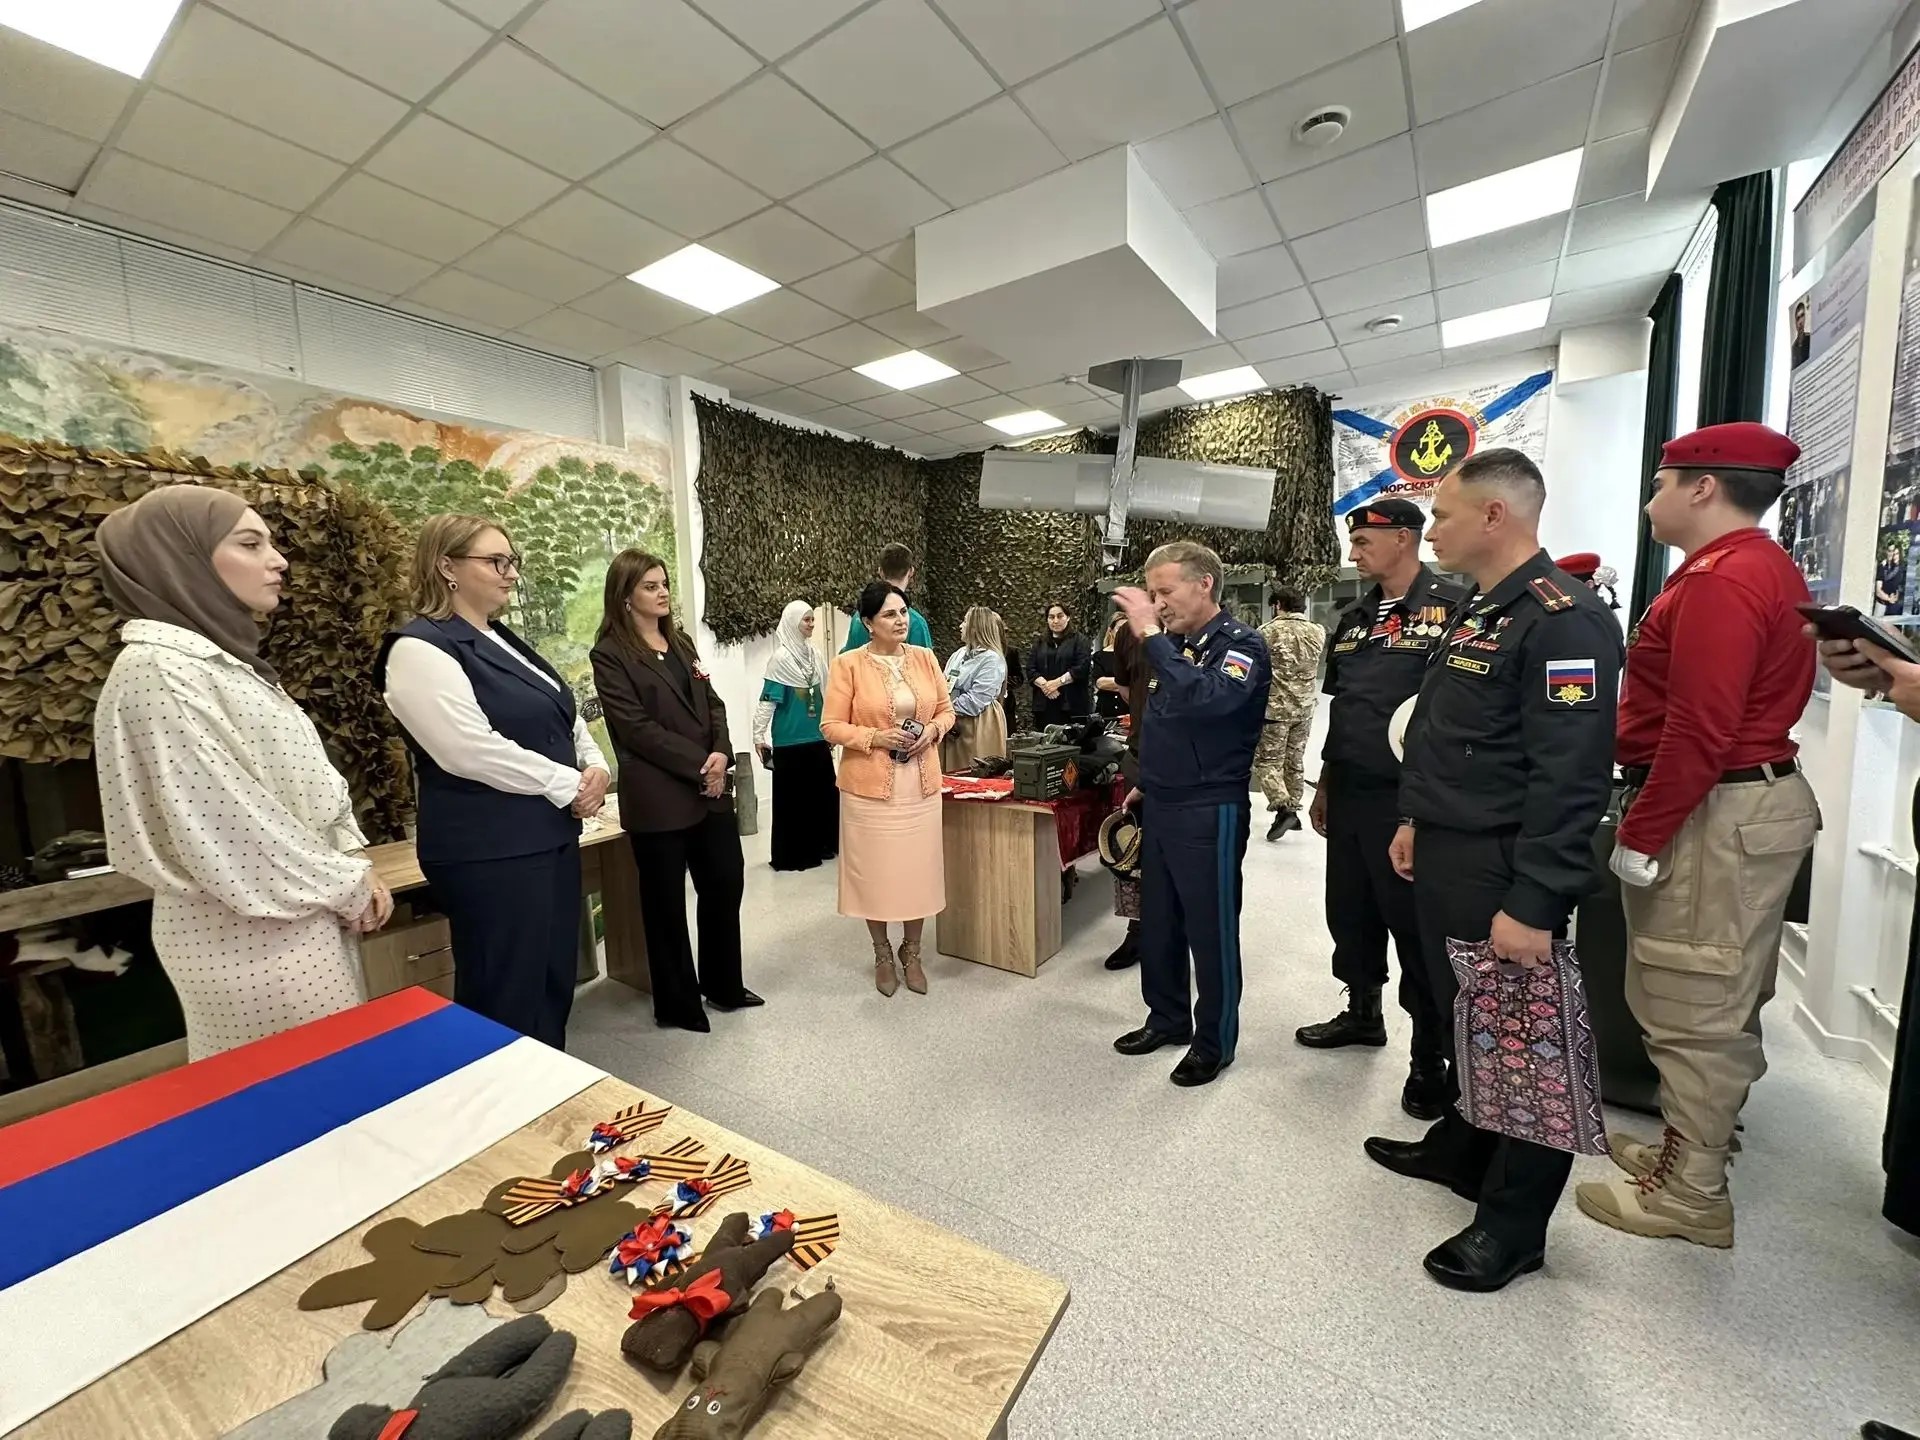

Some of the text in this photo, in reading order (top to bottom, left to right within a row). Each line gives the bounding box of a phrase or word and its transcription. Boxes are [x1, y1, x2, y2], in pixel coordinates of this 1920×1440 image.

[1827, 103, 1883, 189] ОТДЕЛЬНЫЙ
[1844, 119, 1890, 189] МОРСКОЙ
[1380, 481, 1434, 494] МОРСКАЯ
